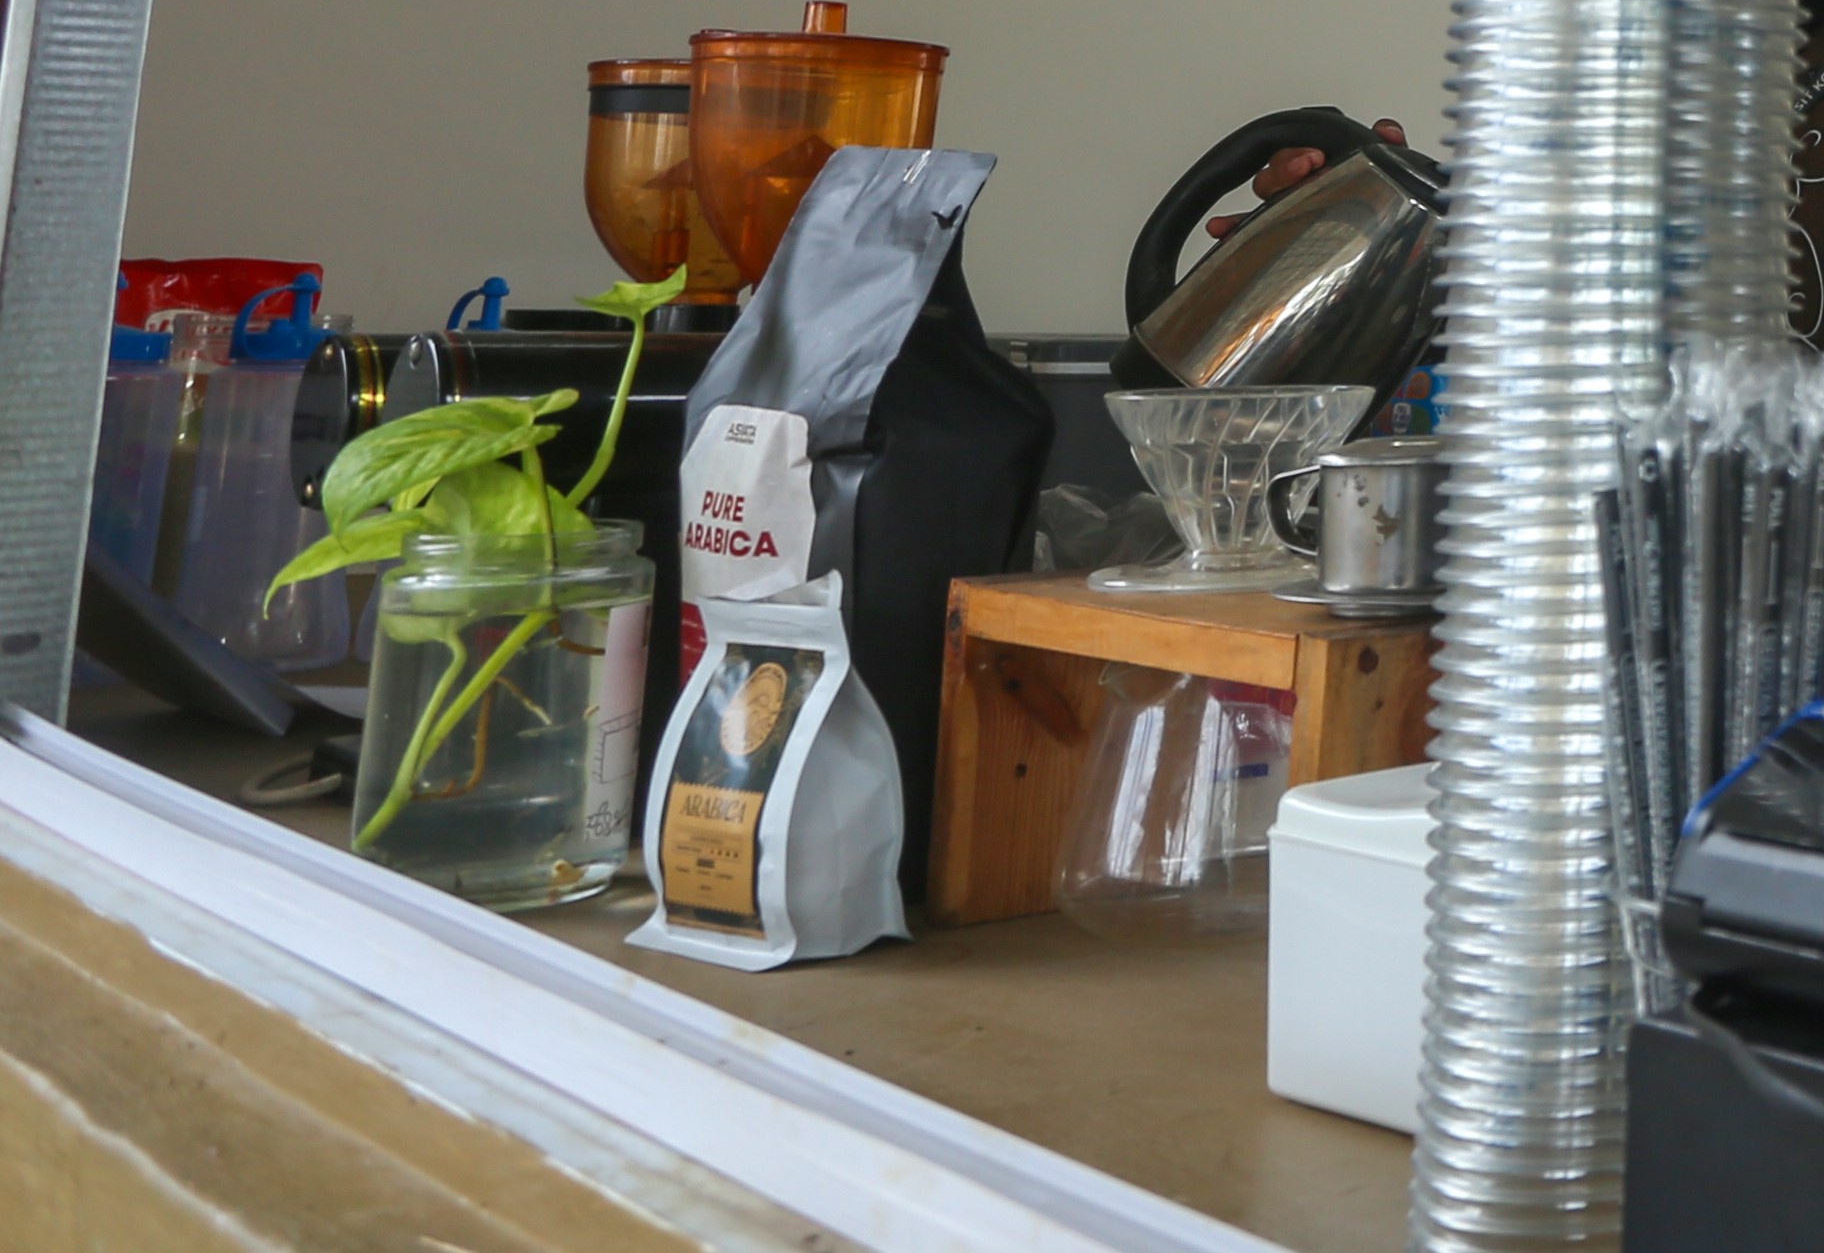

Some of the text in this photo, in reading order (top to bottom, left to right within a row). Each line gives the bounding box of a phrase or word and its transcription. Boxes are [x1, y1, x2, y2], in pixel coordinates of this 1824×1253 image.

[702, 490, 745, 523] PURE
[685, 523, 779, 558] ARABICA
[680, 793, 745, 823] ARABICA
